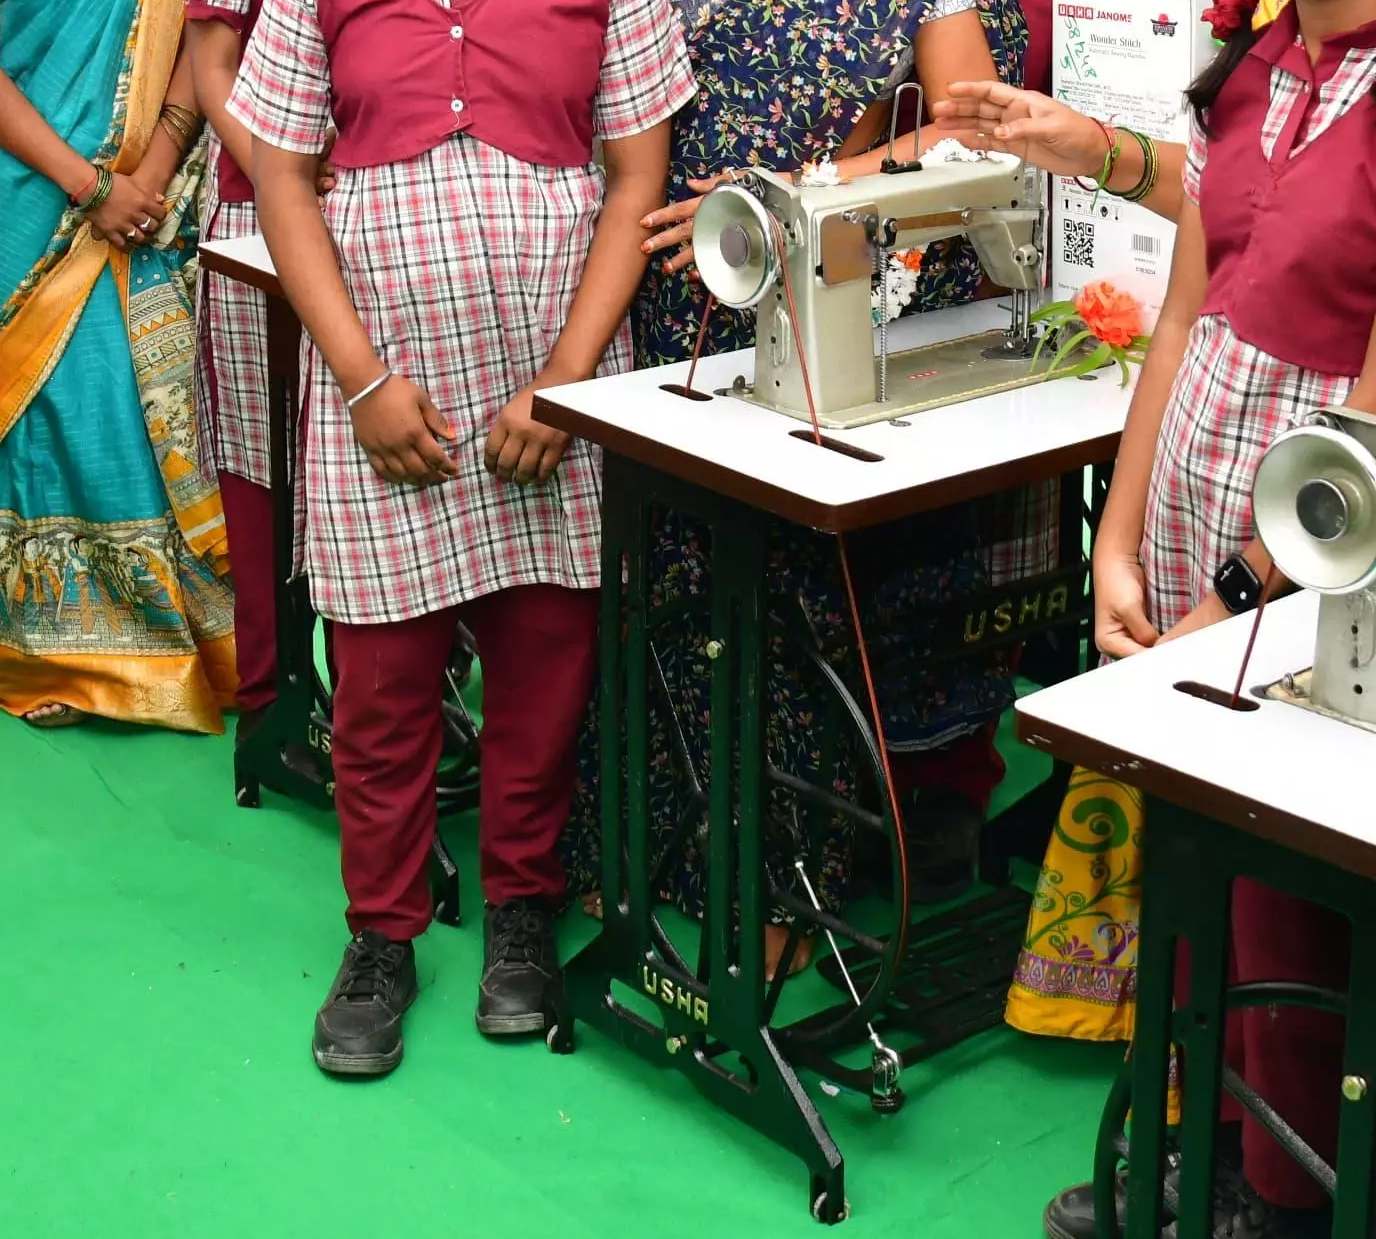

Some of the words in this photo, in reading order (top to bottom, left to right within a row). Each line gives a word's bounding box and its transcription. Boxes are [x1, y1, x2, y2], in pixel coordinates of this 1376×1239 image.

[1096, 10, 1132, 23] JANOME
[1090, 33, 1117, 45] Wonder
[1120, 37, 1141, 48] Stitch
[964, 585, 1068, 642] USHA
[308, 724, 332, 754] US
[643, 965, 709, 1026] USHA
